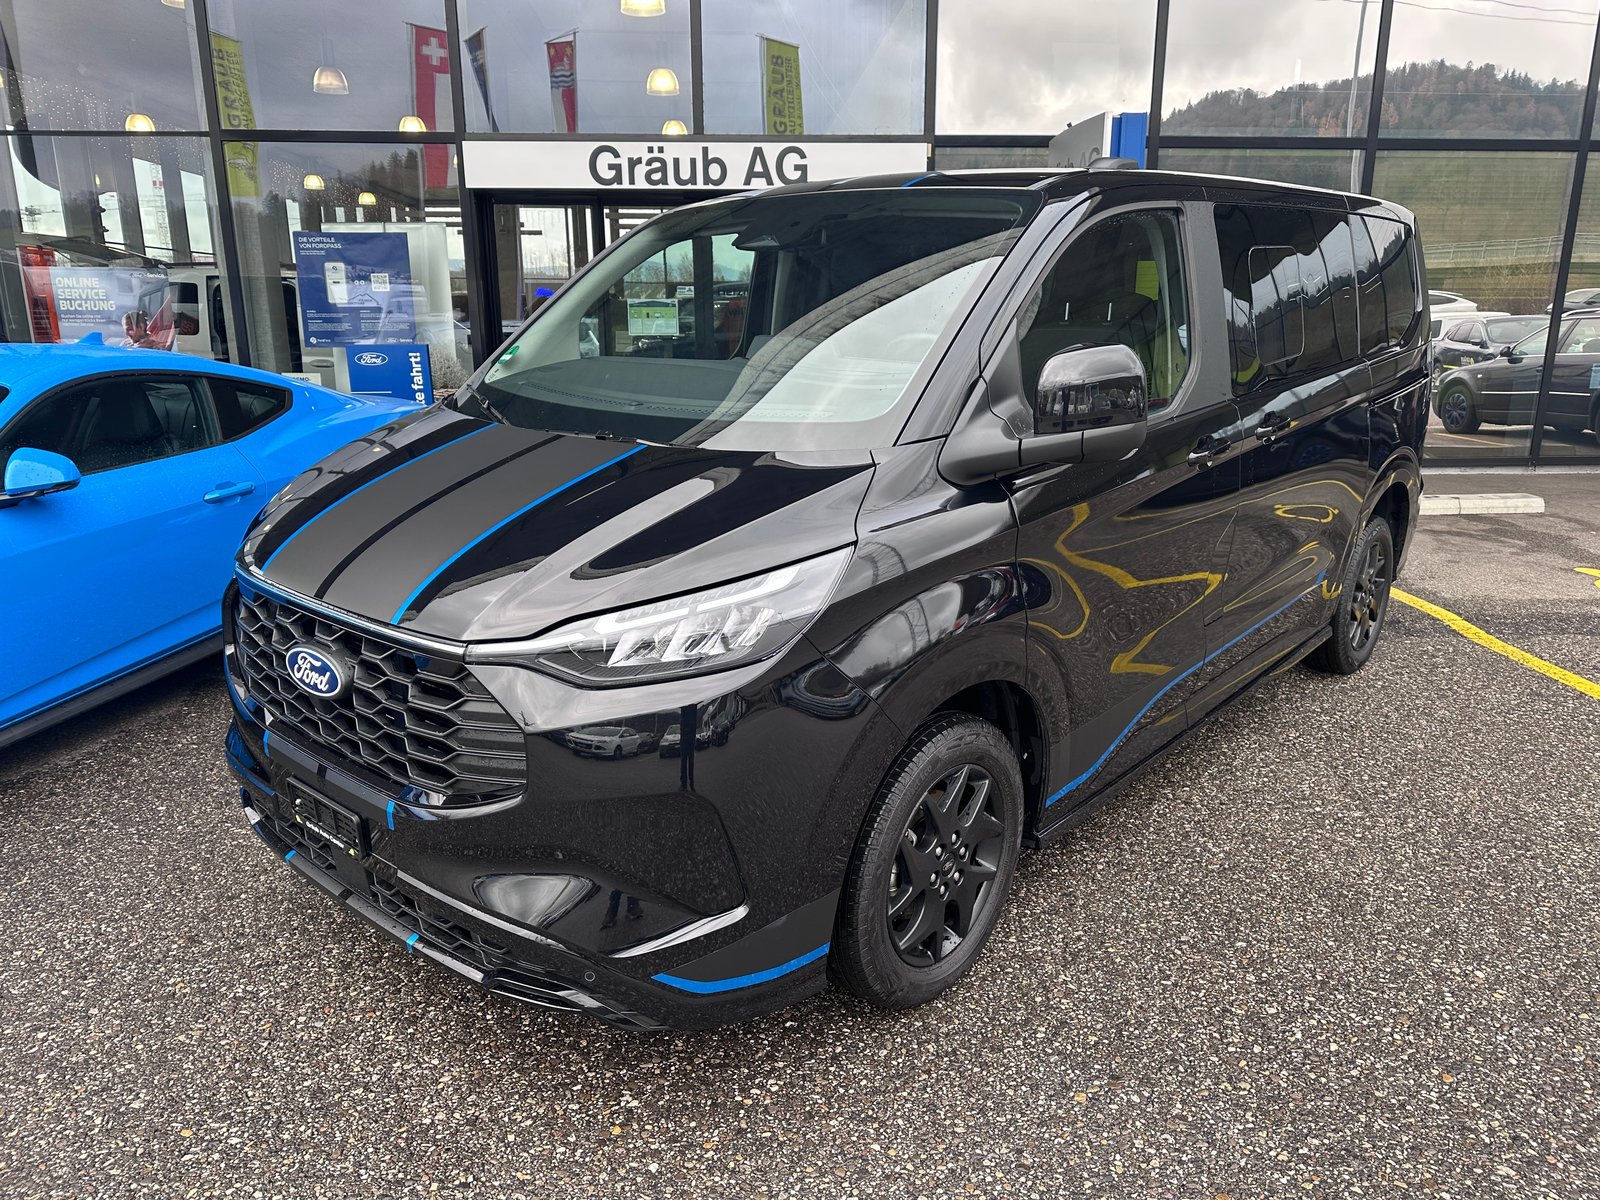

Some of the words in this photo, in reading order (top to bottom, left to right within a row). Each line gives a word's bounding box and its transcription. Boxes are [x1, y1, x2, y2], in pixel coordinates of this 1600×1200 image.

[588, 145, 728, 187] Gräub
[743, 145, 809, 187] AG
[56, 277, 100, 288] ONLINE
[58, 289, 106, 300] SERVICE
[60, 300, 116, 311] BUCHUNG
[360, 352, 383, 365] Ford
[408, 352, 424, 391] fahrt!
[294, 652, 331, 691] Ford
